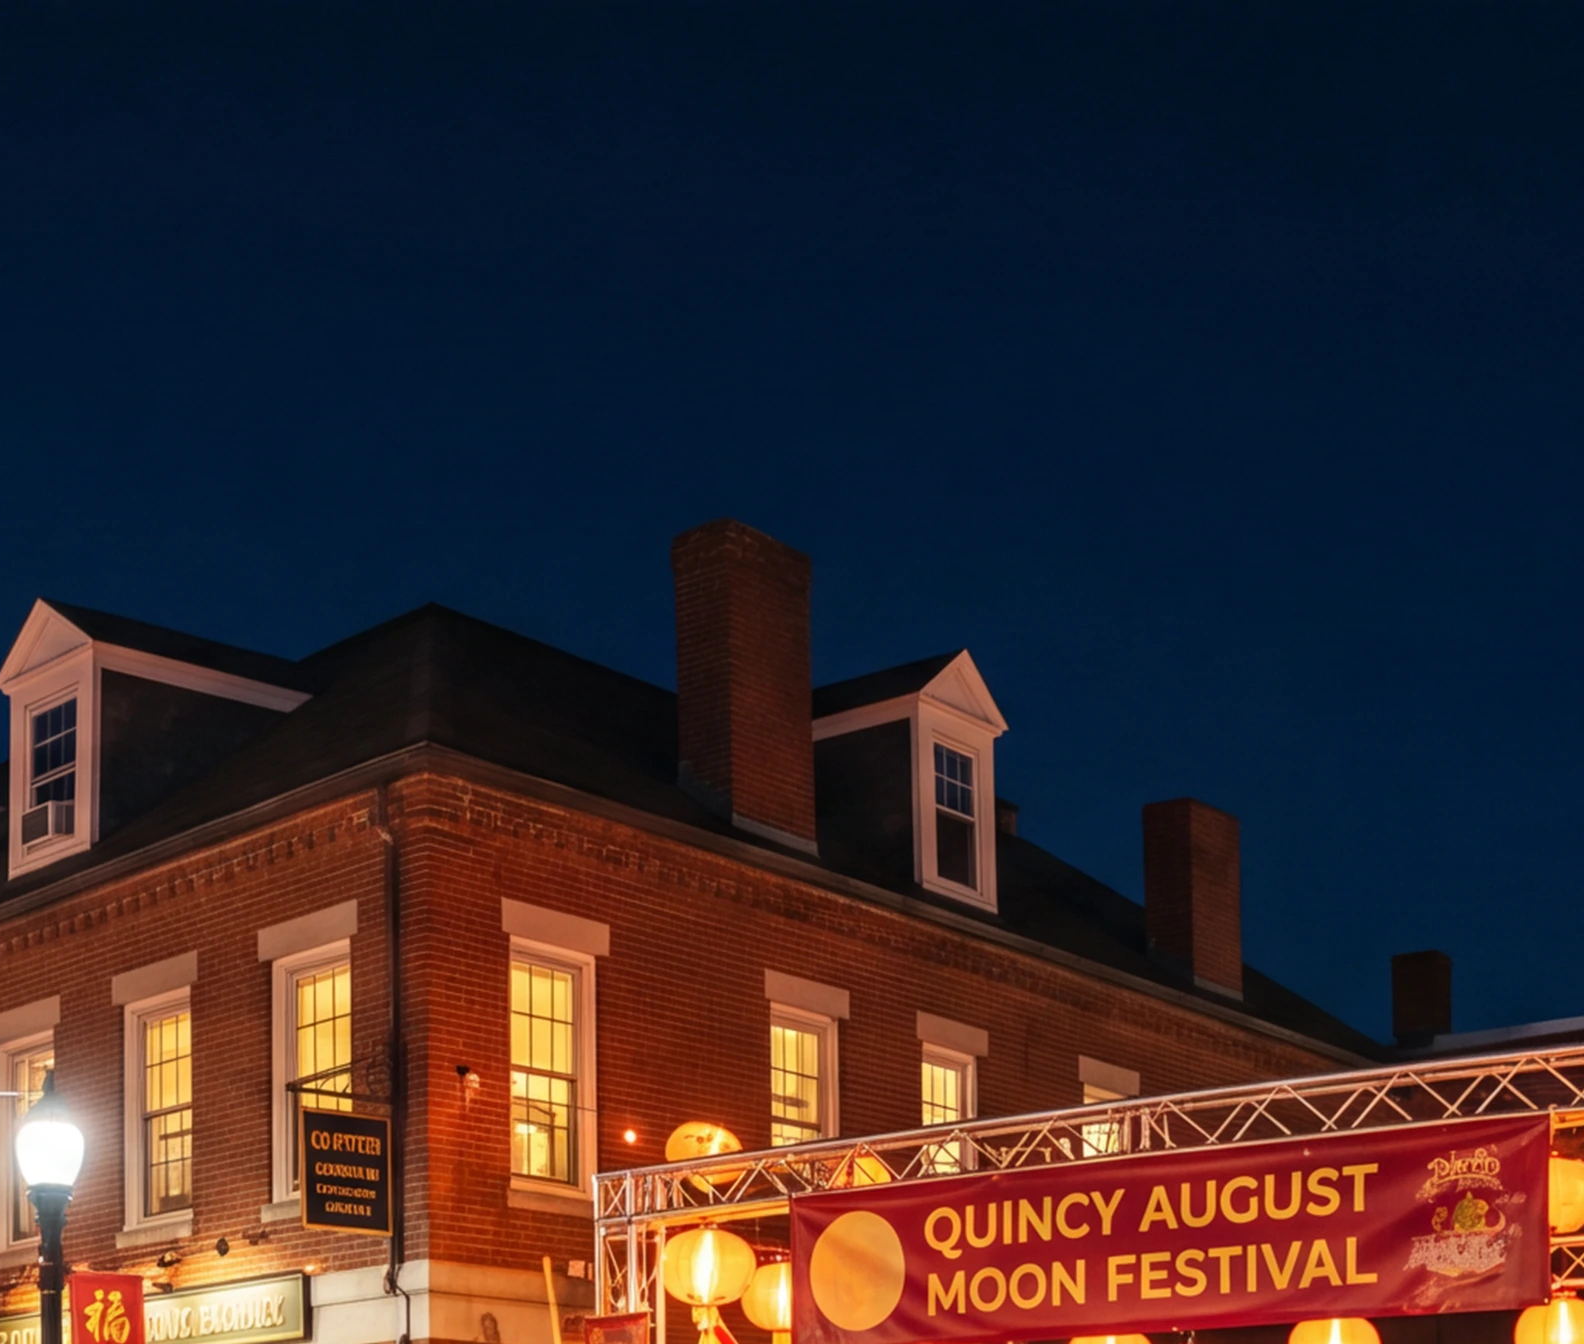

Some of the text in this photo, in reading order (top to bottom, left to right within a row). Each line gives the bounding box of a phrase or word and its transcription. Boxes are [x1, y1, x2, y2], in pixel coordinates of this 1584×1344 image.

[925, 1189, 1124, 1260] QUINCY
[1139, 1164, 1378, 1231] AUGUST
[928, 1237, 1377, 1316] MOON FESTIVAL
